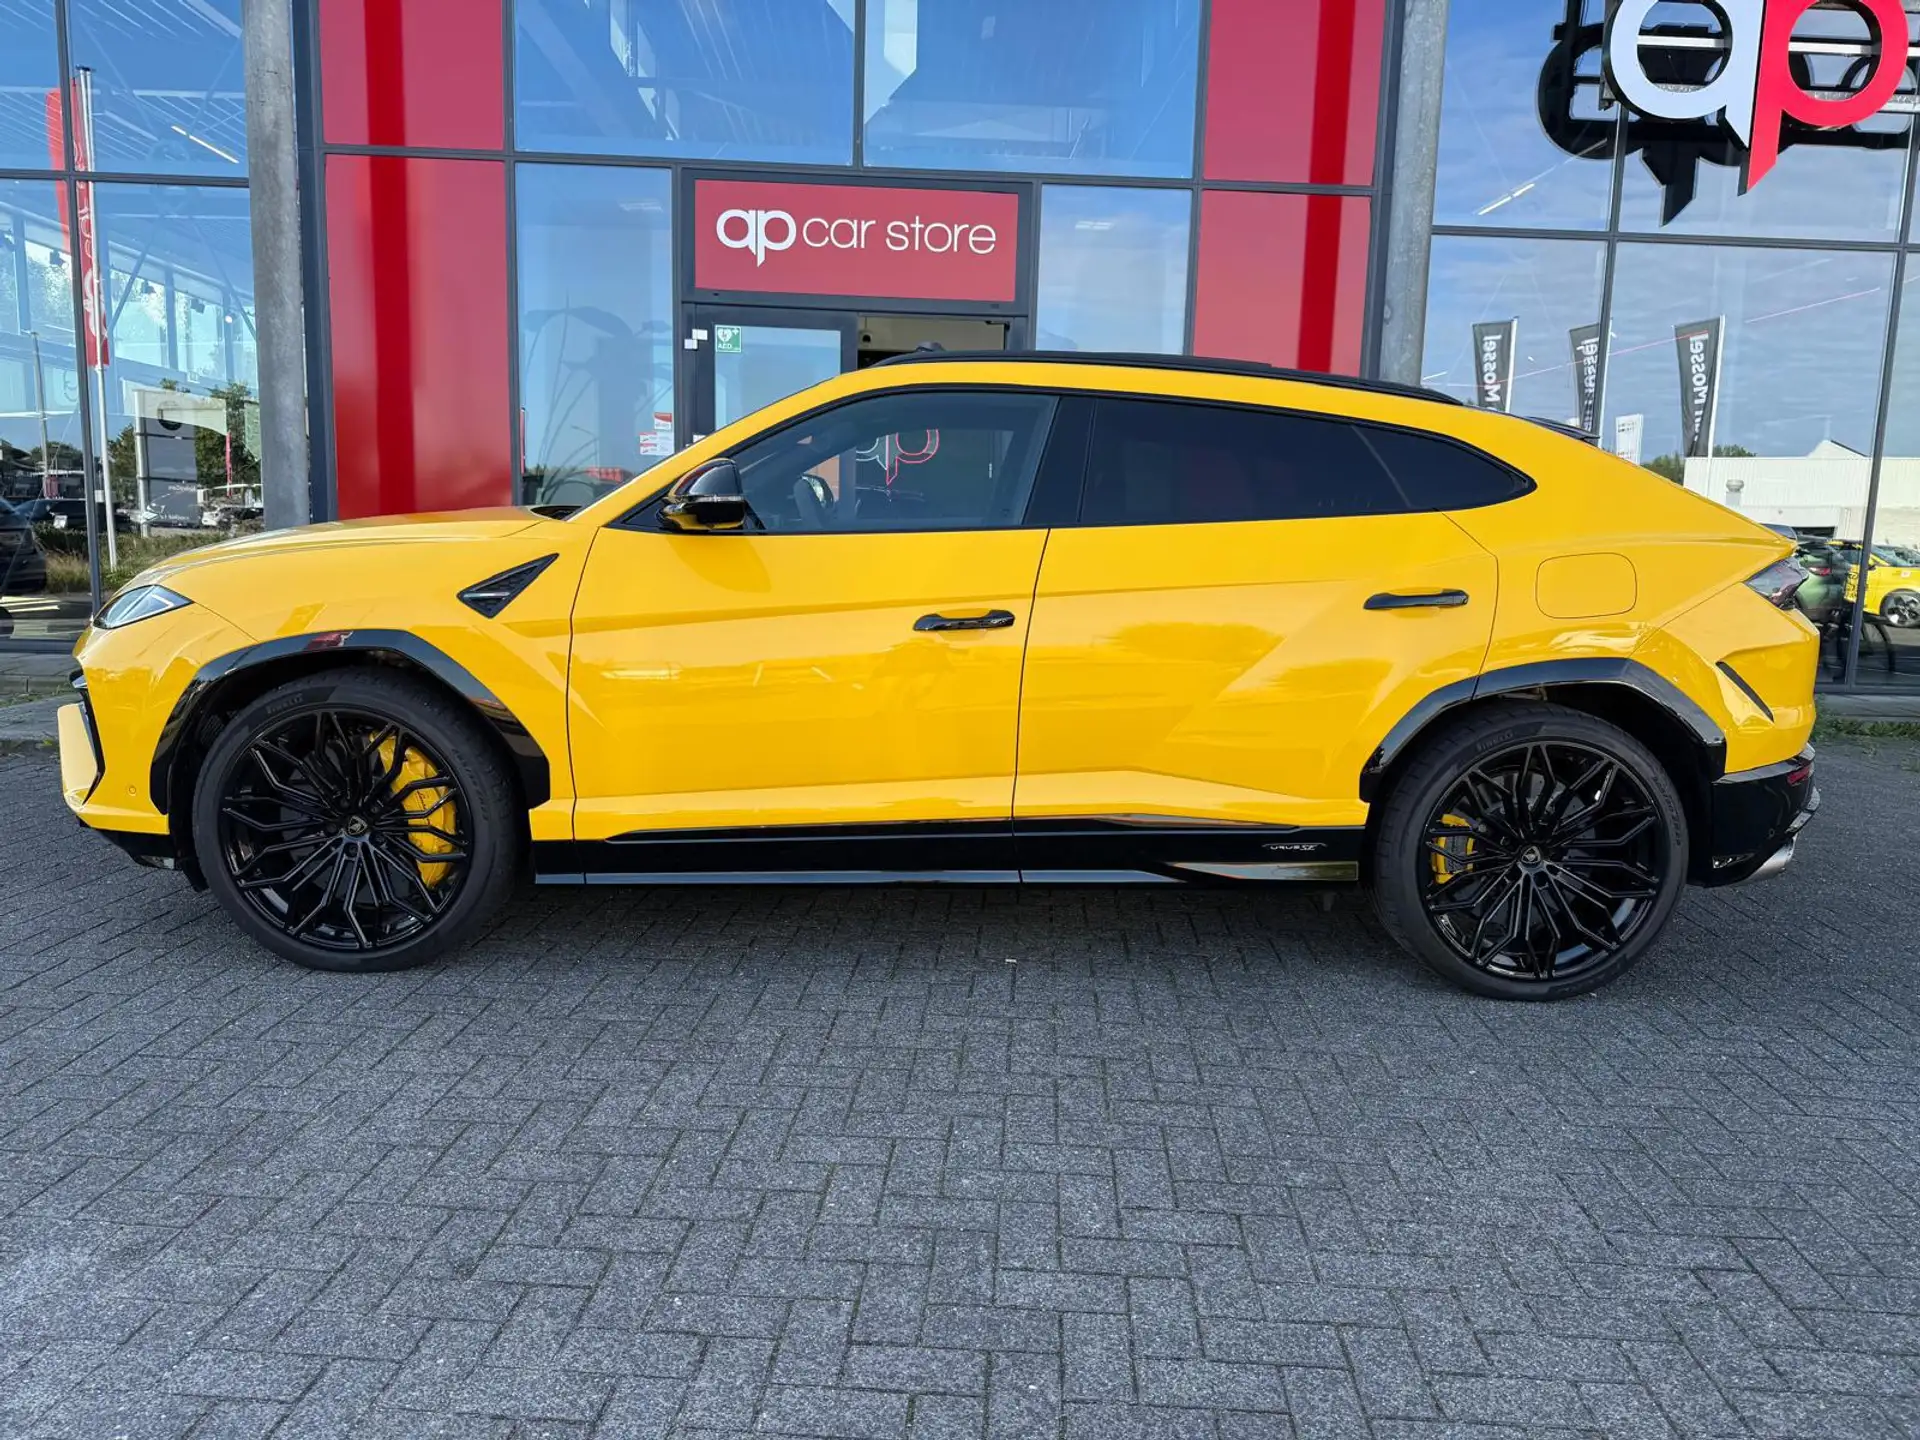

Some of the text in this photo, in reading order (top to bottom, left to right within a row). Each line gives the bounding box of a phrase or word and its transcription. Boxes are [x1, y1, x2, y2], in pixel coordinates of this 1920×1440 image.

[716, 208, 997, 267] ap car store
